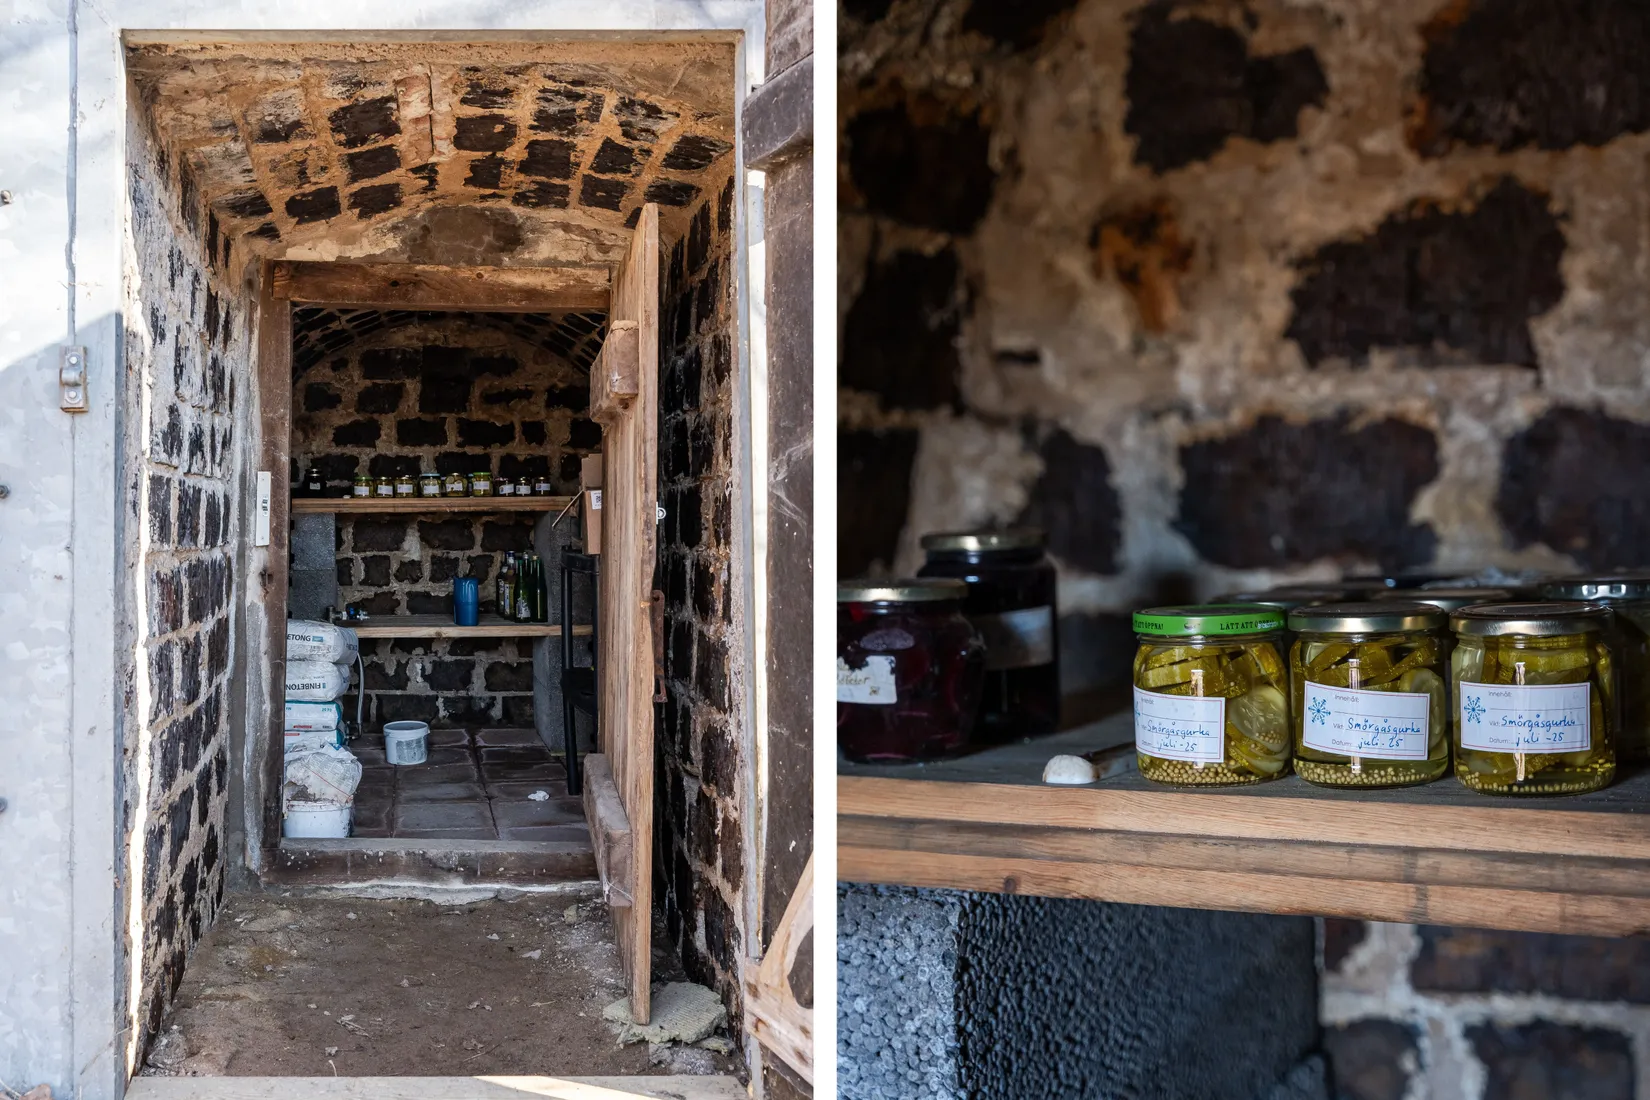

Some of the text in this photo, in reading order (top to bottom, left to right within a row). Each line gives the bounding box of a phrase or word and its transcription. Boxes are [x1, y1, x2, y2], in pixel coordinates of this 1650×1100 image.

[1348, 717, 1421, 739] Smörgåsgurka
[1157, 738, 1176, 752] juli
[1516, 732, 1540, 747] juli
